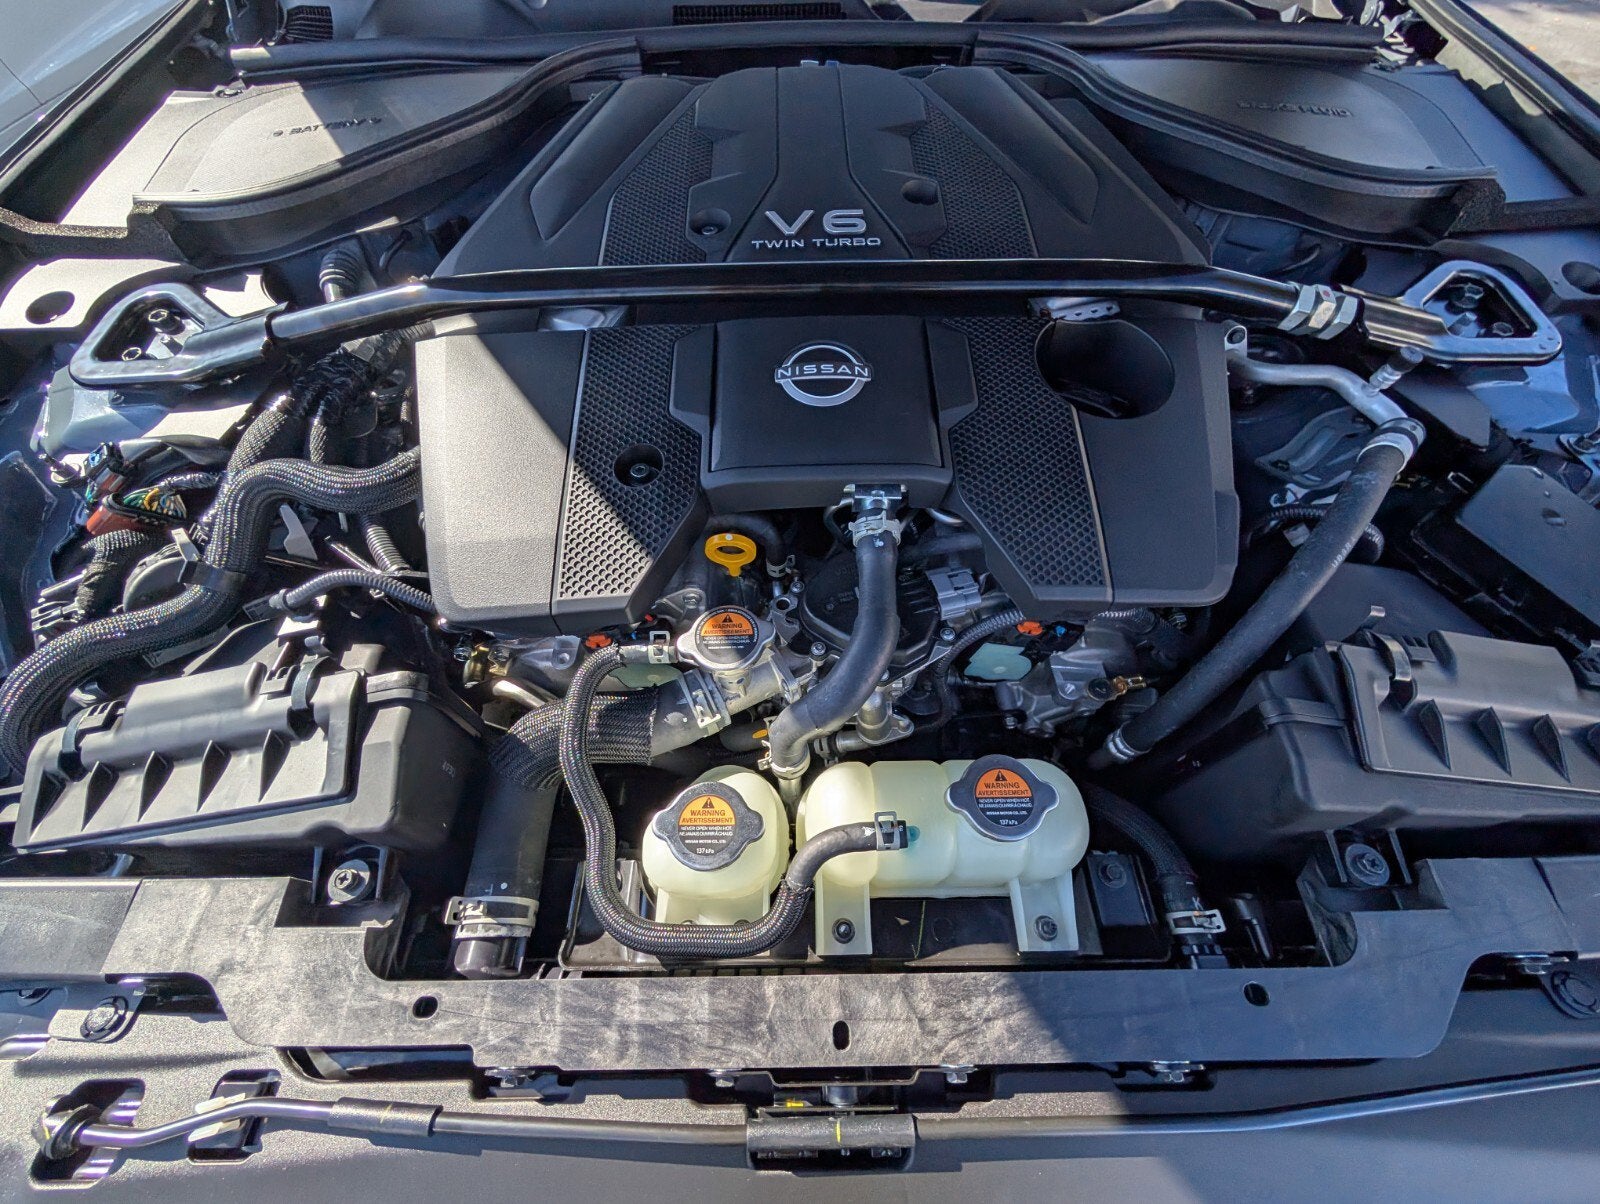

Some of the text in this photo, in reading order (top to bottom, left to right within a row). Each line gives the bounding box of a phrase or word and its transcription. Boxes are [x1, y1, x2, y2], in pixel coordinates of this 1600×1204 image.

[765, 209, 867, 236] V6
[751, 237, 881, 249] TWIN TURBO
[777, 364, 869, 378] NISSAN
